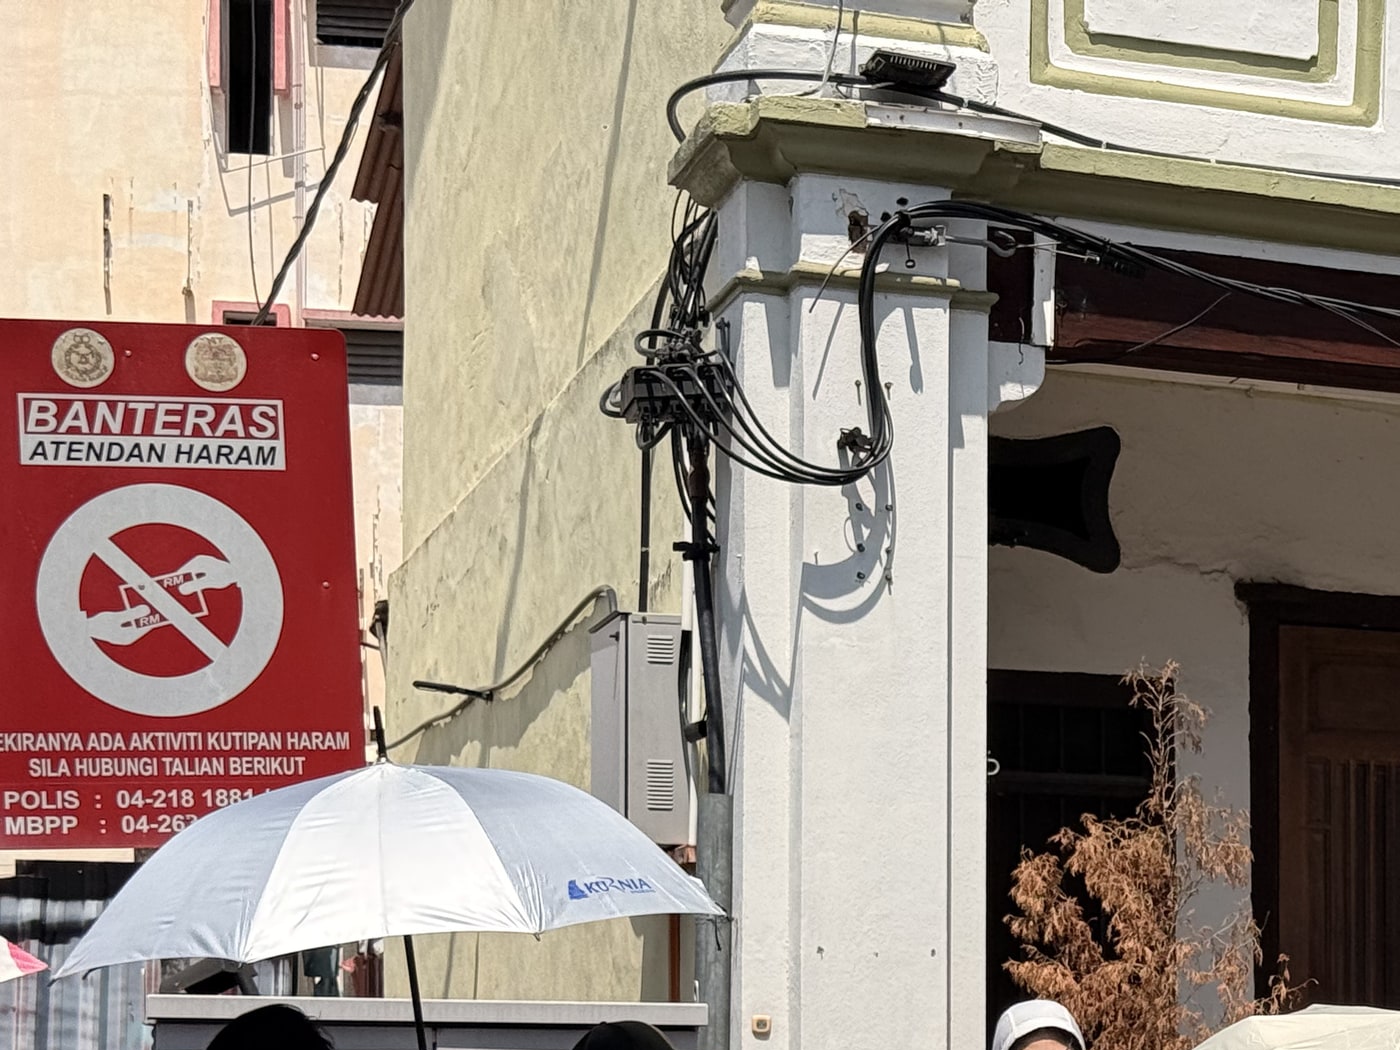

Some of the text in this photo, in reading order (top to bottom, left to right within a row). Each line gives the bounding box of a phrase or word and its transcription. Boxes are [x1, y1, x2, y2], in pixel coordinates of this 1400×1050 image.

[26, 400, 277, 439] BANTERAS
[29, 440, 277, 466] ATENDAN HARAM
[163, 575, 184, 588] RM
[139, 613, 160, 627] RM
[87, 732, 126, 751] ADA
[130, 732, 201, 751] AKTIVITI
[208, 732, 282, 750] KUTIPAN
[287, 732, 350, 750] HARAM
[28, 756, 306, 777] SILA HUBUNGI TALIAN BERIKUT
[3, 790, 80, 810] POLIS
[116, 789, 195, 808] 04-218
[4, 815, 79, 835] MBPP
